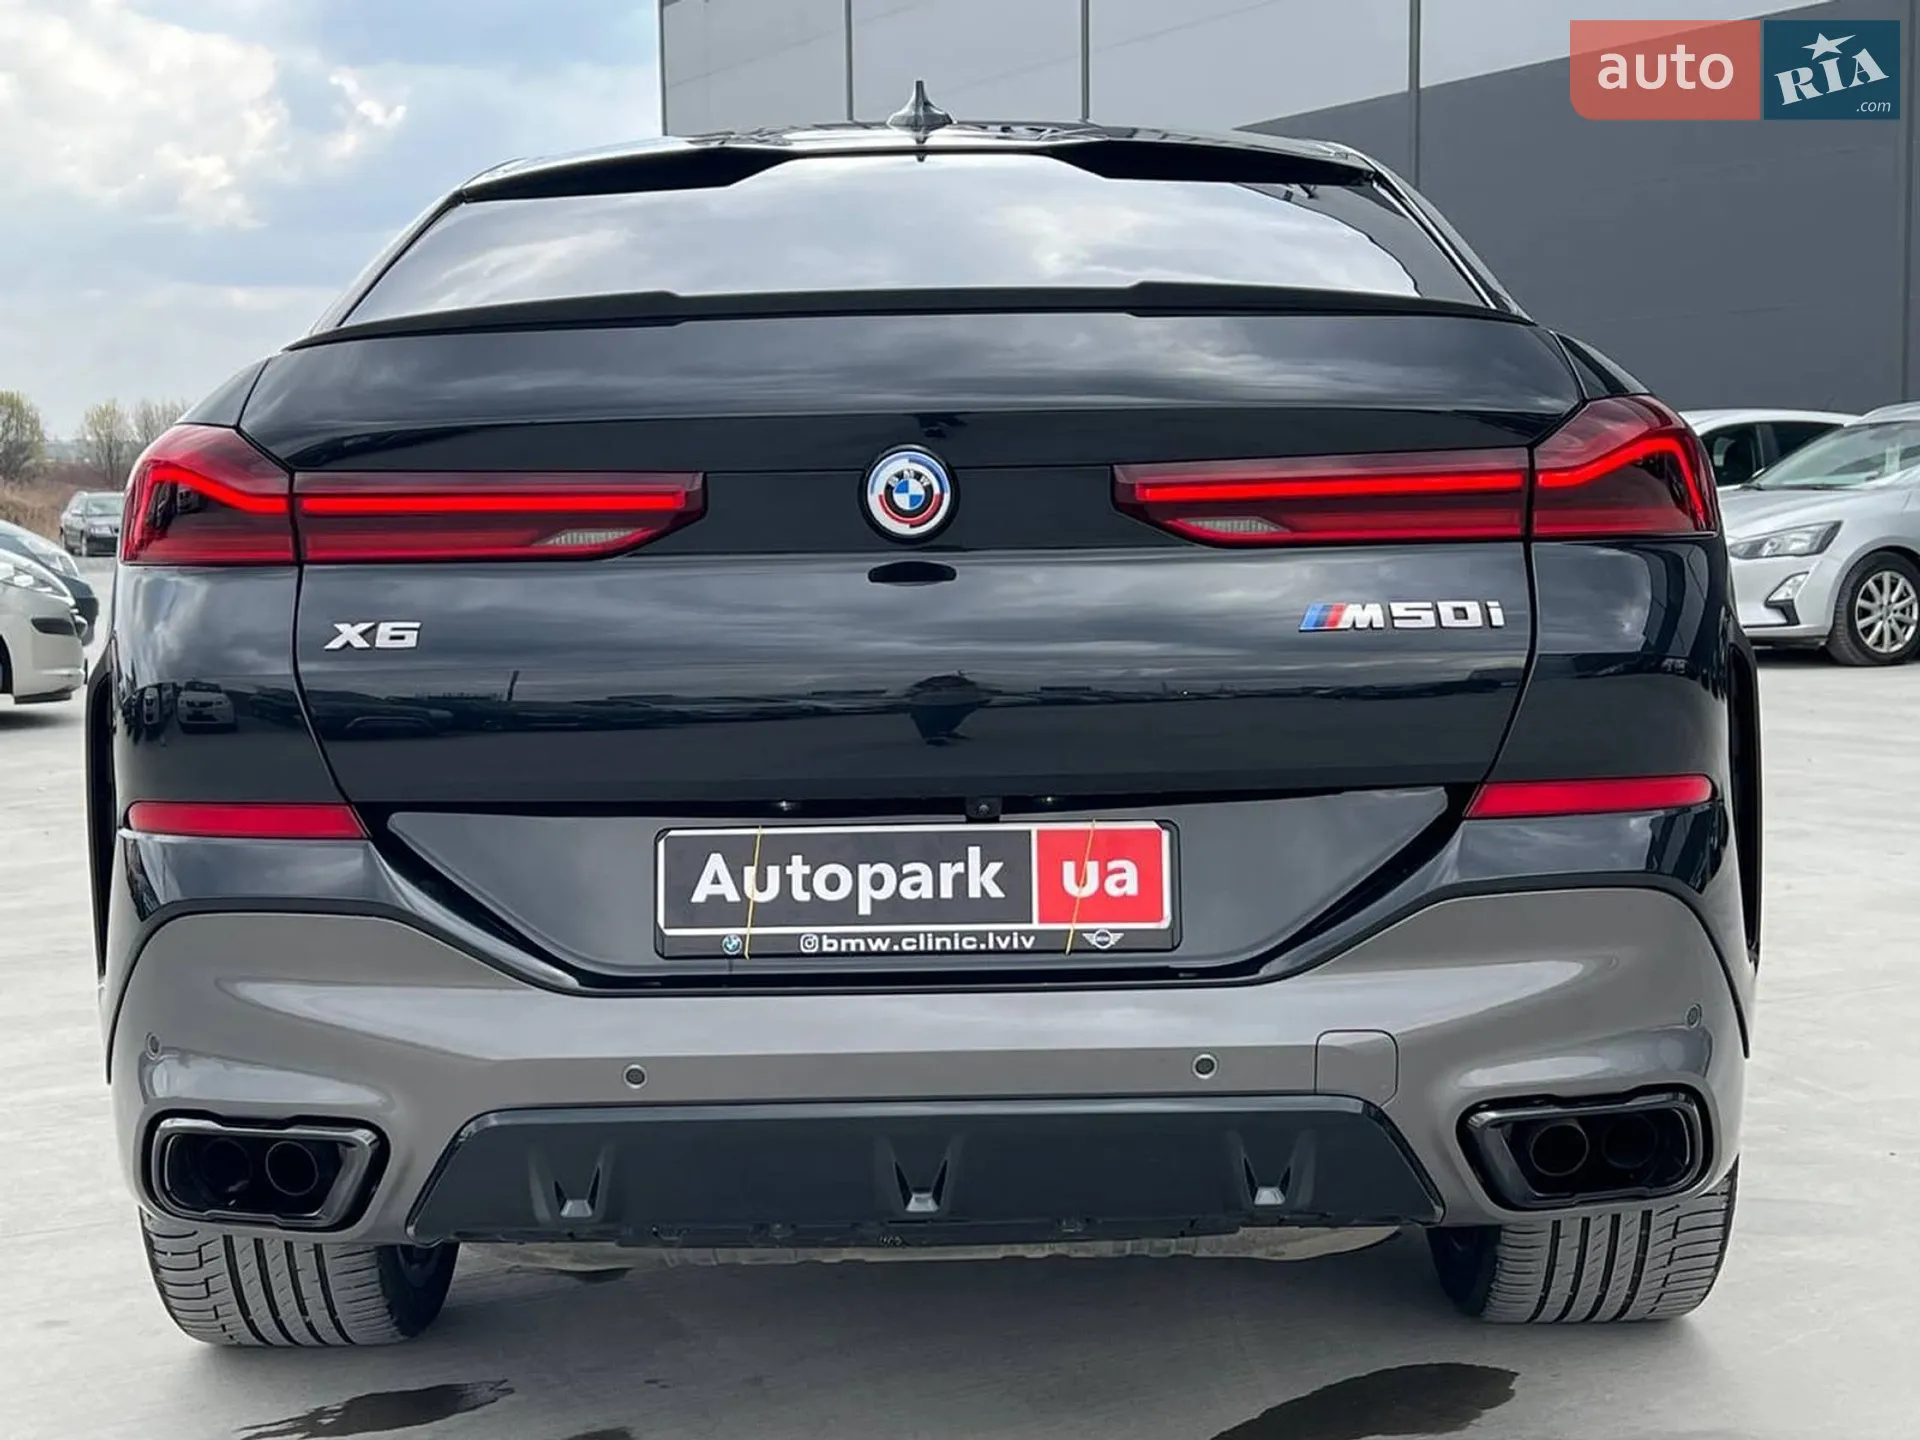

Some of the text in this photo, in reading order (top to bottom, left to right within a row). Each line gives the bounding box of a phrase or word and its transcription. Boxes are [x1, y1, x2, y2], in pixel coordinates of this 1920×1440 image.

[323, 621, 422, 650] X6
[690, 846, 1140, 916] Autopark ua
